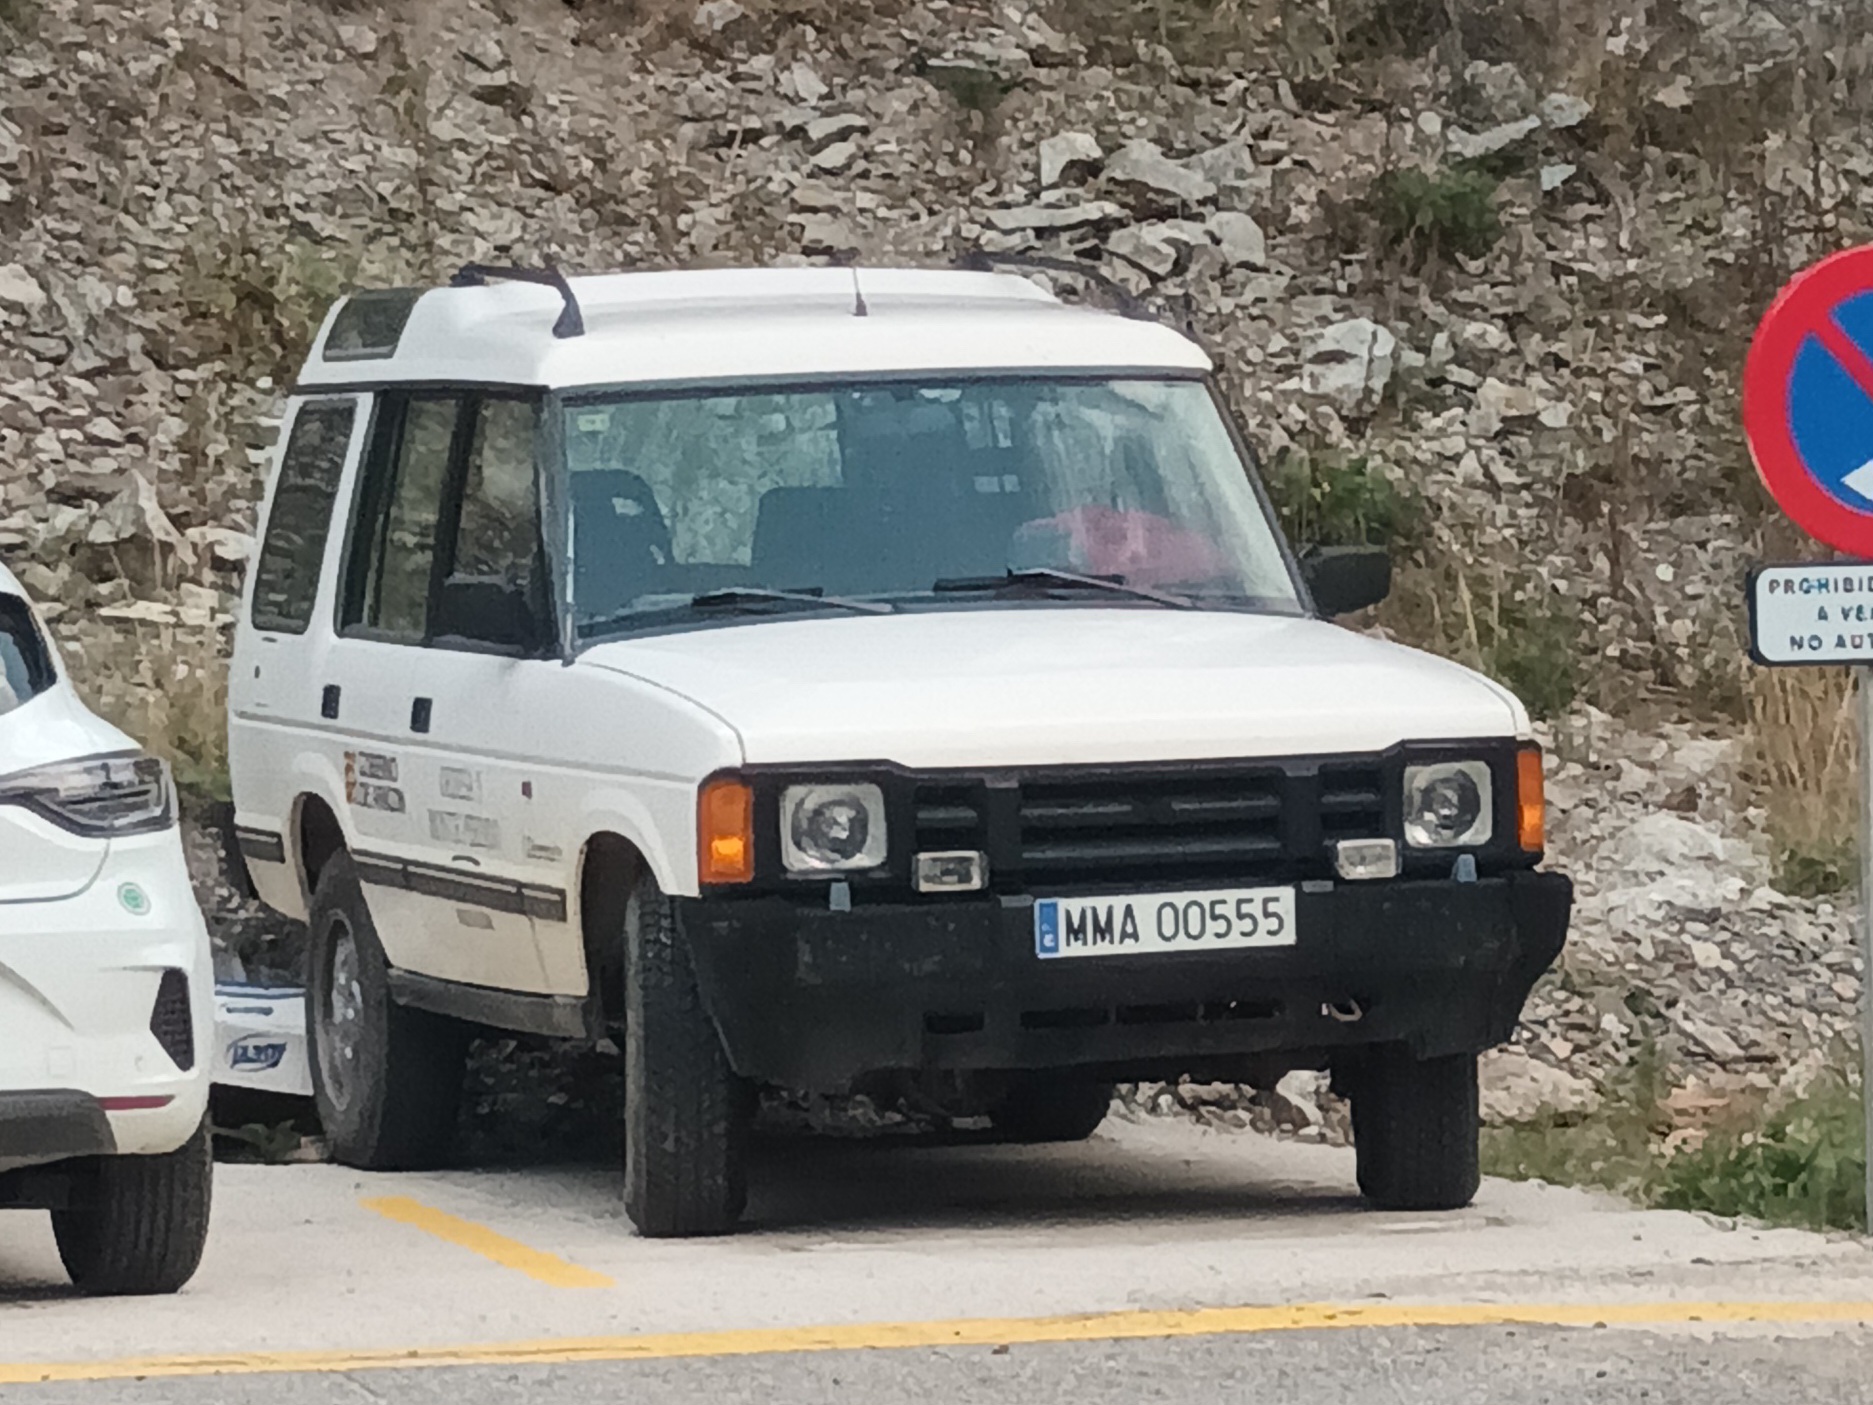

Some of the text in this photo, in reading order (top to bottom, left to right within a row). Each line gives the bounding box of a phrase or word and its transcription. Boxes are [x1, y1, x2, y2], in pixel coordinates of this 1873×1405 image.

[1817, 605, 1829, 621] A
[1789, 634, 1823, 651] NO
[1065, 897, 1285, 947] MMA 00555
